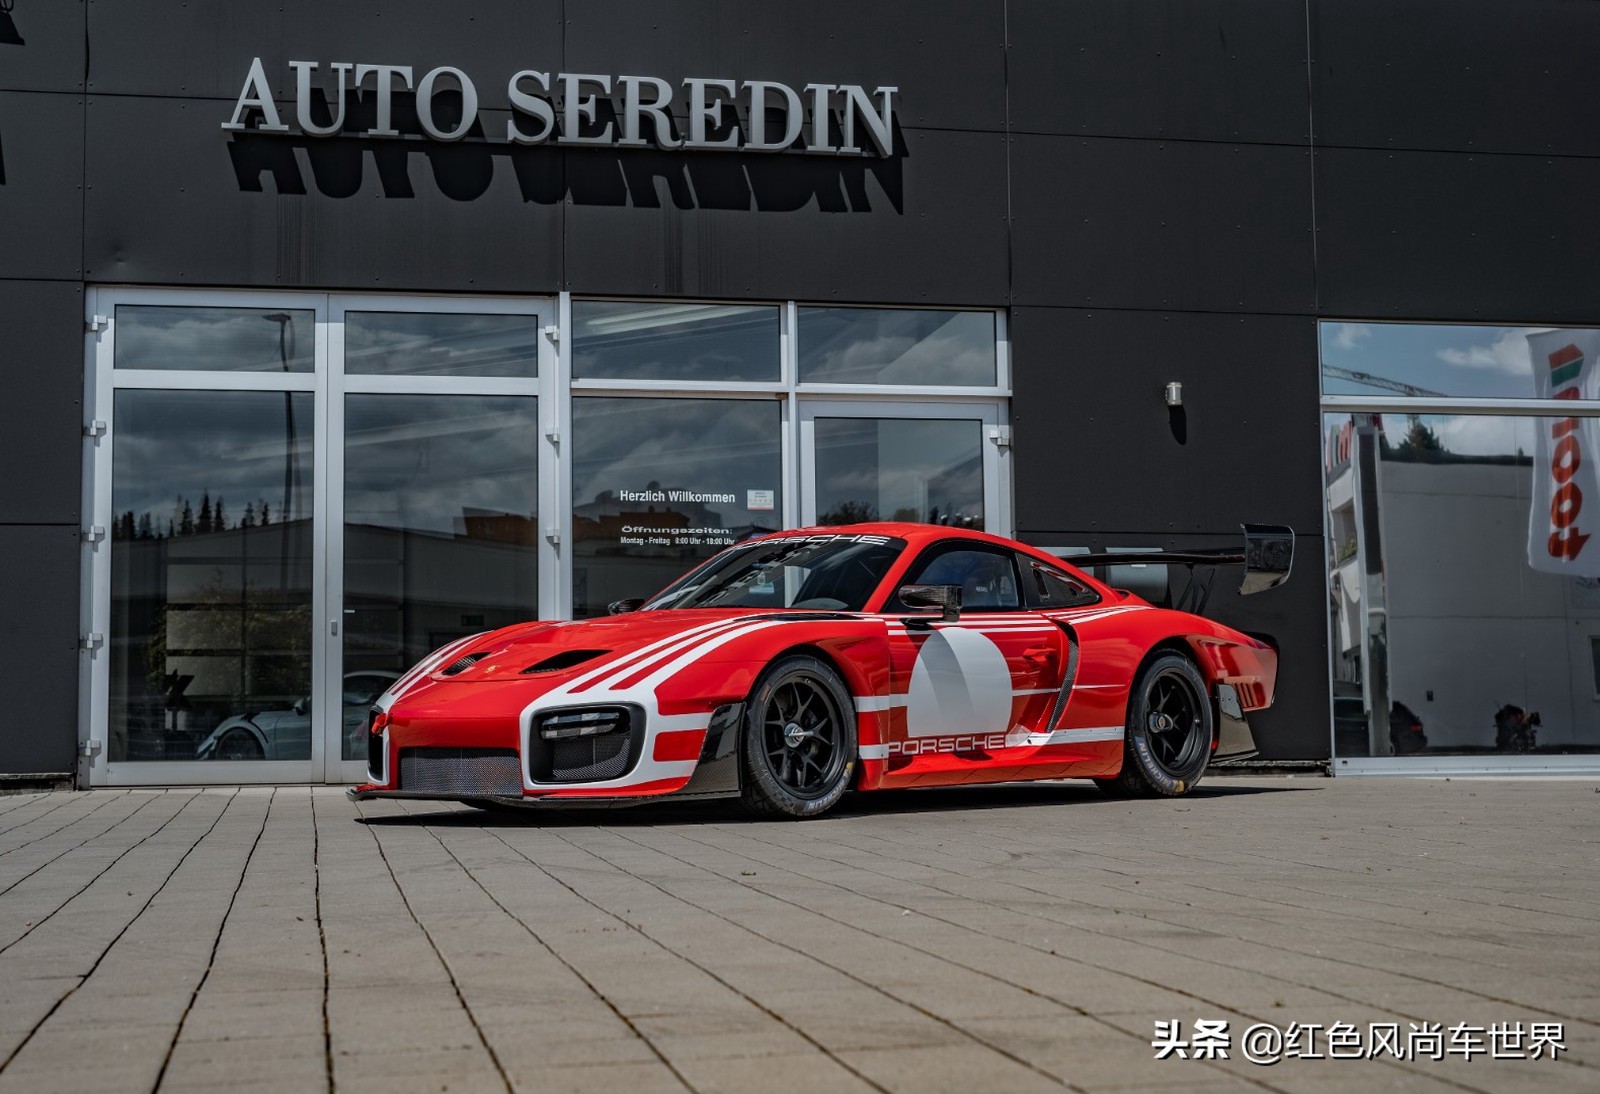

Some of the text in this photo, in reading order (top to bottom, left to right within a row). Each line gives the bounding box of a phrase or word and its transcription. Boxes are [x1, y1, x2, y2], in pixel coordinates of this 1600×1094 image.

[221, 56, 899, 159] AUTO SEREDIN
[620, 489, 666, 502] Herzlich
[668, 490, 736, 503] Willkommen
[621, 525, 733, 535] Öffnungszeiten:
[620, 536, 644, 546] Montag
[648, 536, 671, 546] Freitag
[689, 537, 702, 545] Uhr
[706, 537, 723, 546] 18:00
[723, 538, 736, 546] Uhr
[728, 534, 891, 553] ORSCHE
[887, 735, 1006, 755] PORSCHE
